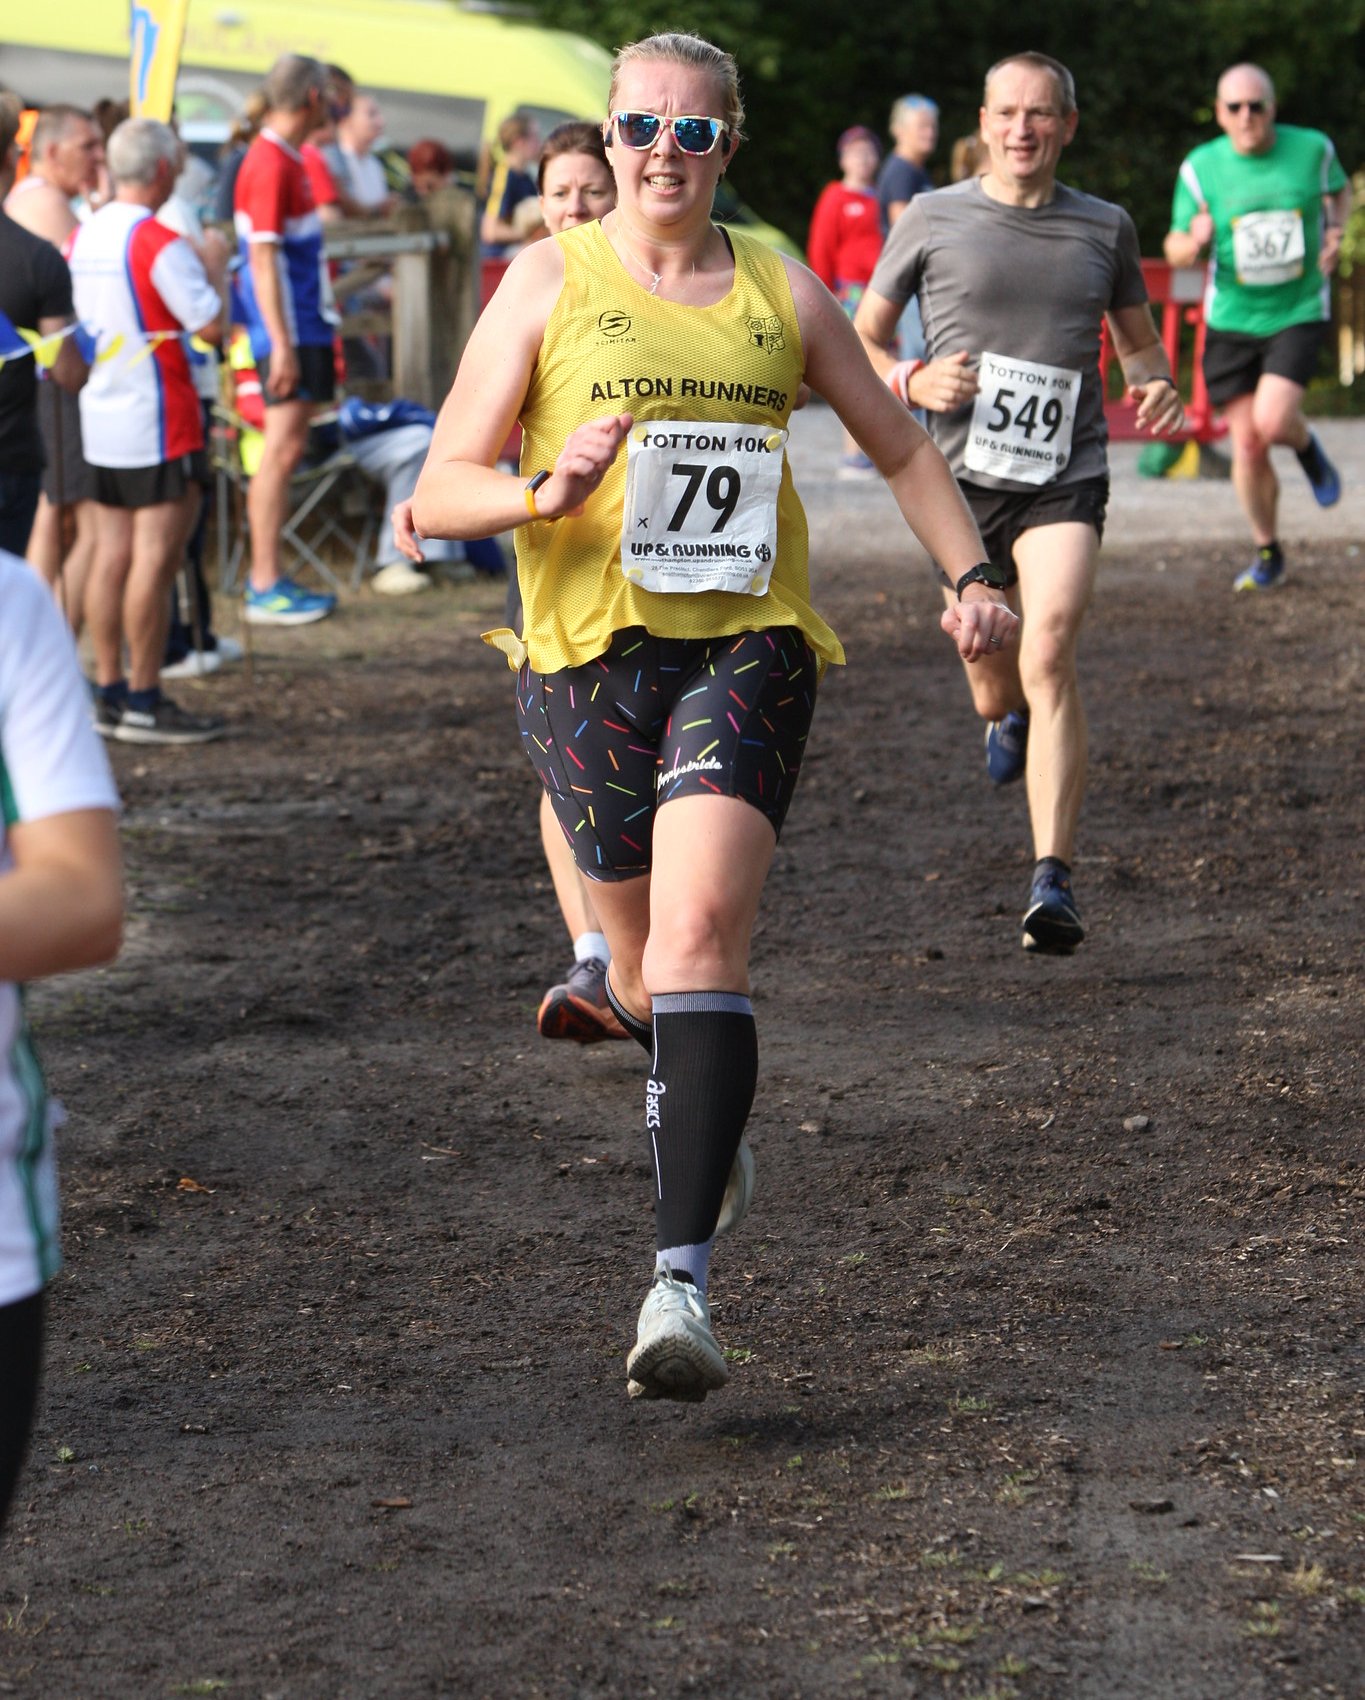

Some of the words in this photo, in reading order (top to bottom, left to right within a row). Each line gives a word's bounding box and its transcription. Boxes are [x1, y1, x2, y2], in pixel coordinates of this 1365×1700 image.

[1247, 230, 1291, 259] 367
[989, 364, 1047, 386] TOTTON
[591, 378, 672, 401] ALTON
[681, 378, 788, 411] RUNNERS
[987, 388, 1063, 443] 549
[643, 434, 726, 451] TOTTON
[733, 437, 771, 454] 10K
[1000, 443, 1053, 461] RUNNING
[667, 464, 741, 533] 79
[672, 544, 750, 557] RUNNING
